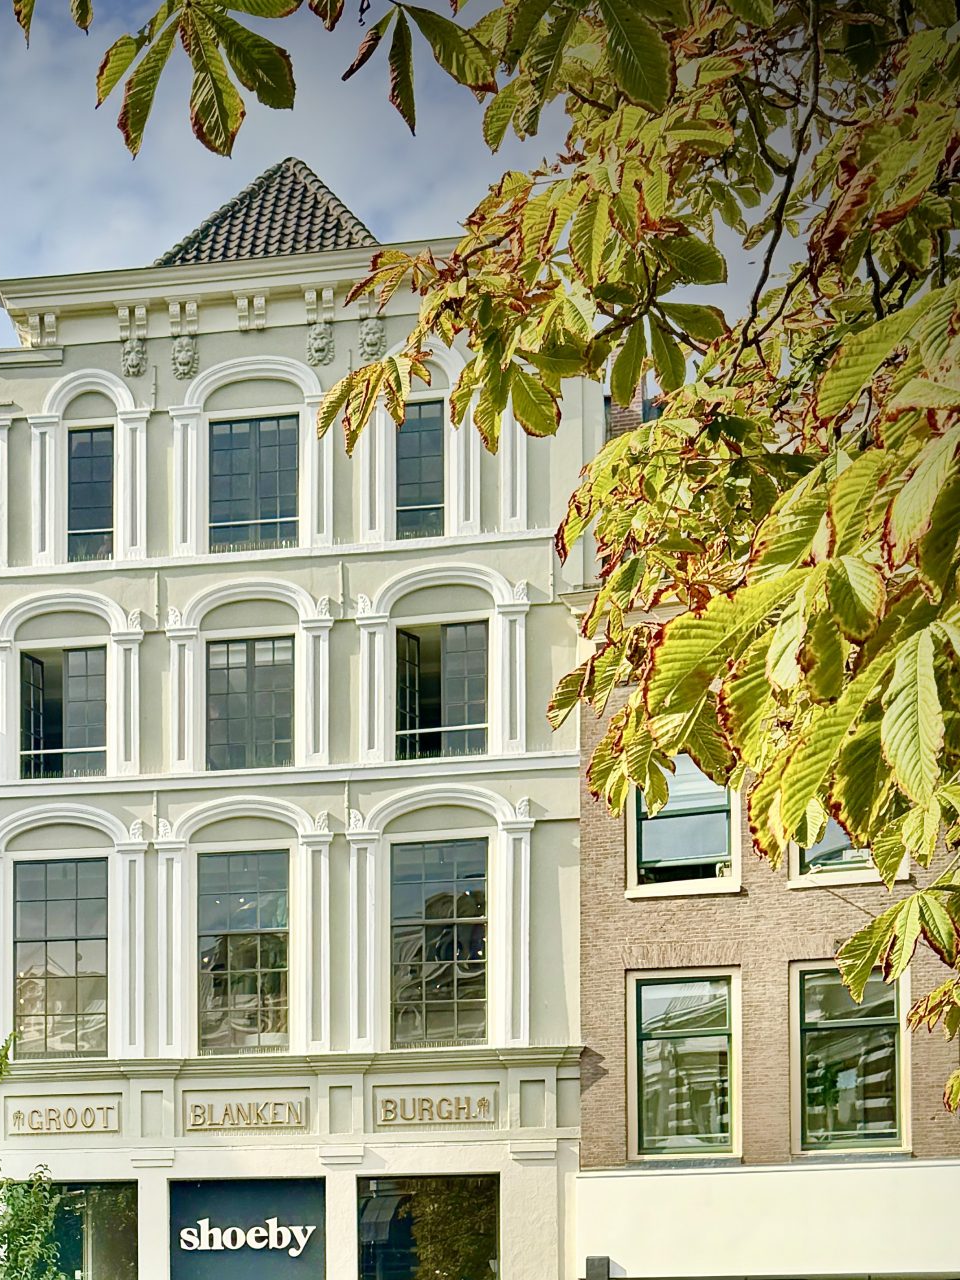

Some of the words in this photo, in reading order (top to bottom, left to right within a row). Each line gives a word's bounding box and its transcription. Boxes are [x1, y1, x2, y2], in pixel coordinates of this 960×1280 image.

[27, 1106, 115, 1130] GROOT
[191, 1101, 301, 1126] BLANKEN
[381, 1096, 477, 1121] BURGH.
[180, 1217, 316, 1257] shoeby
